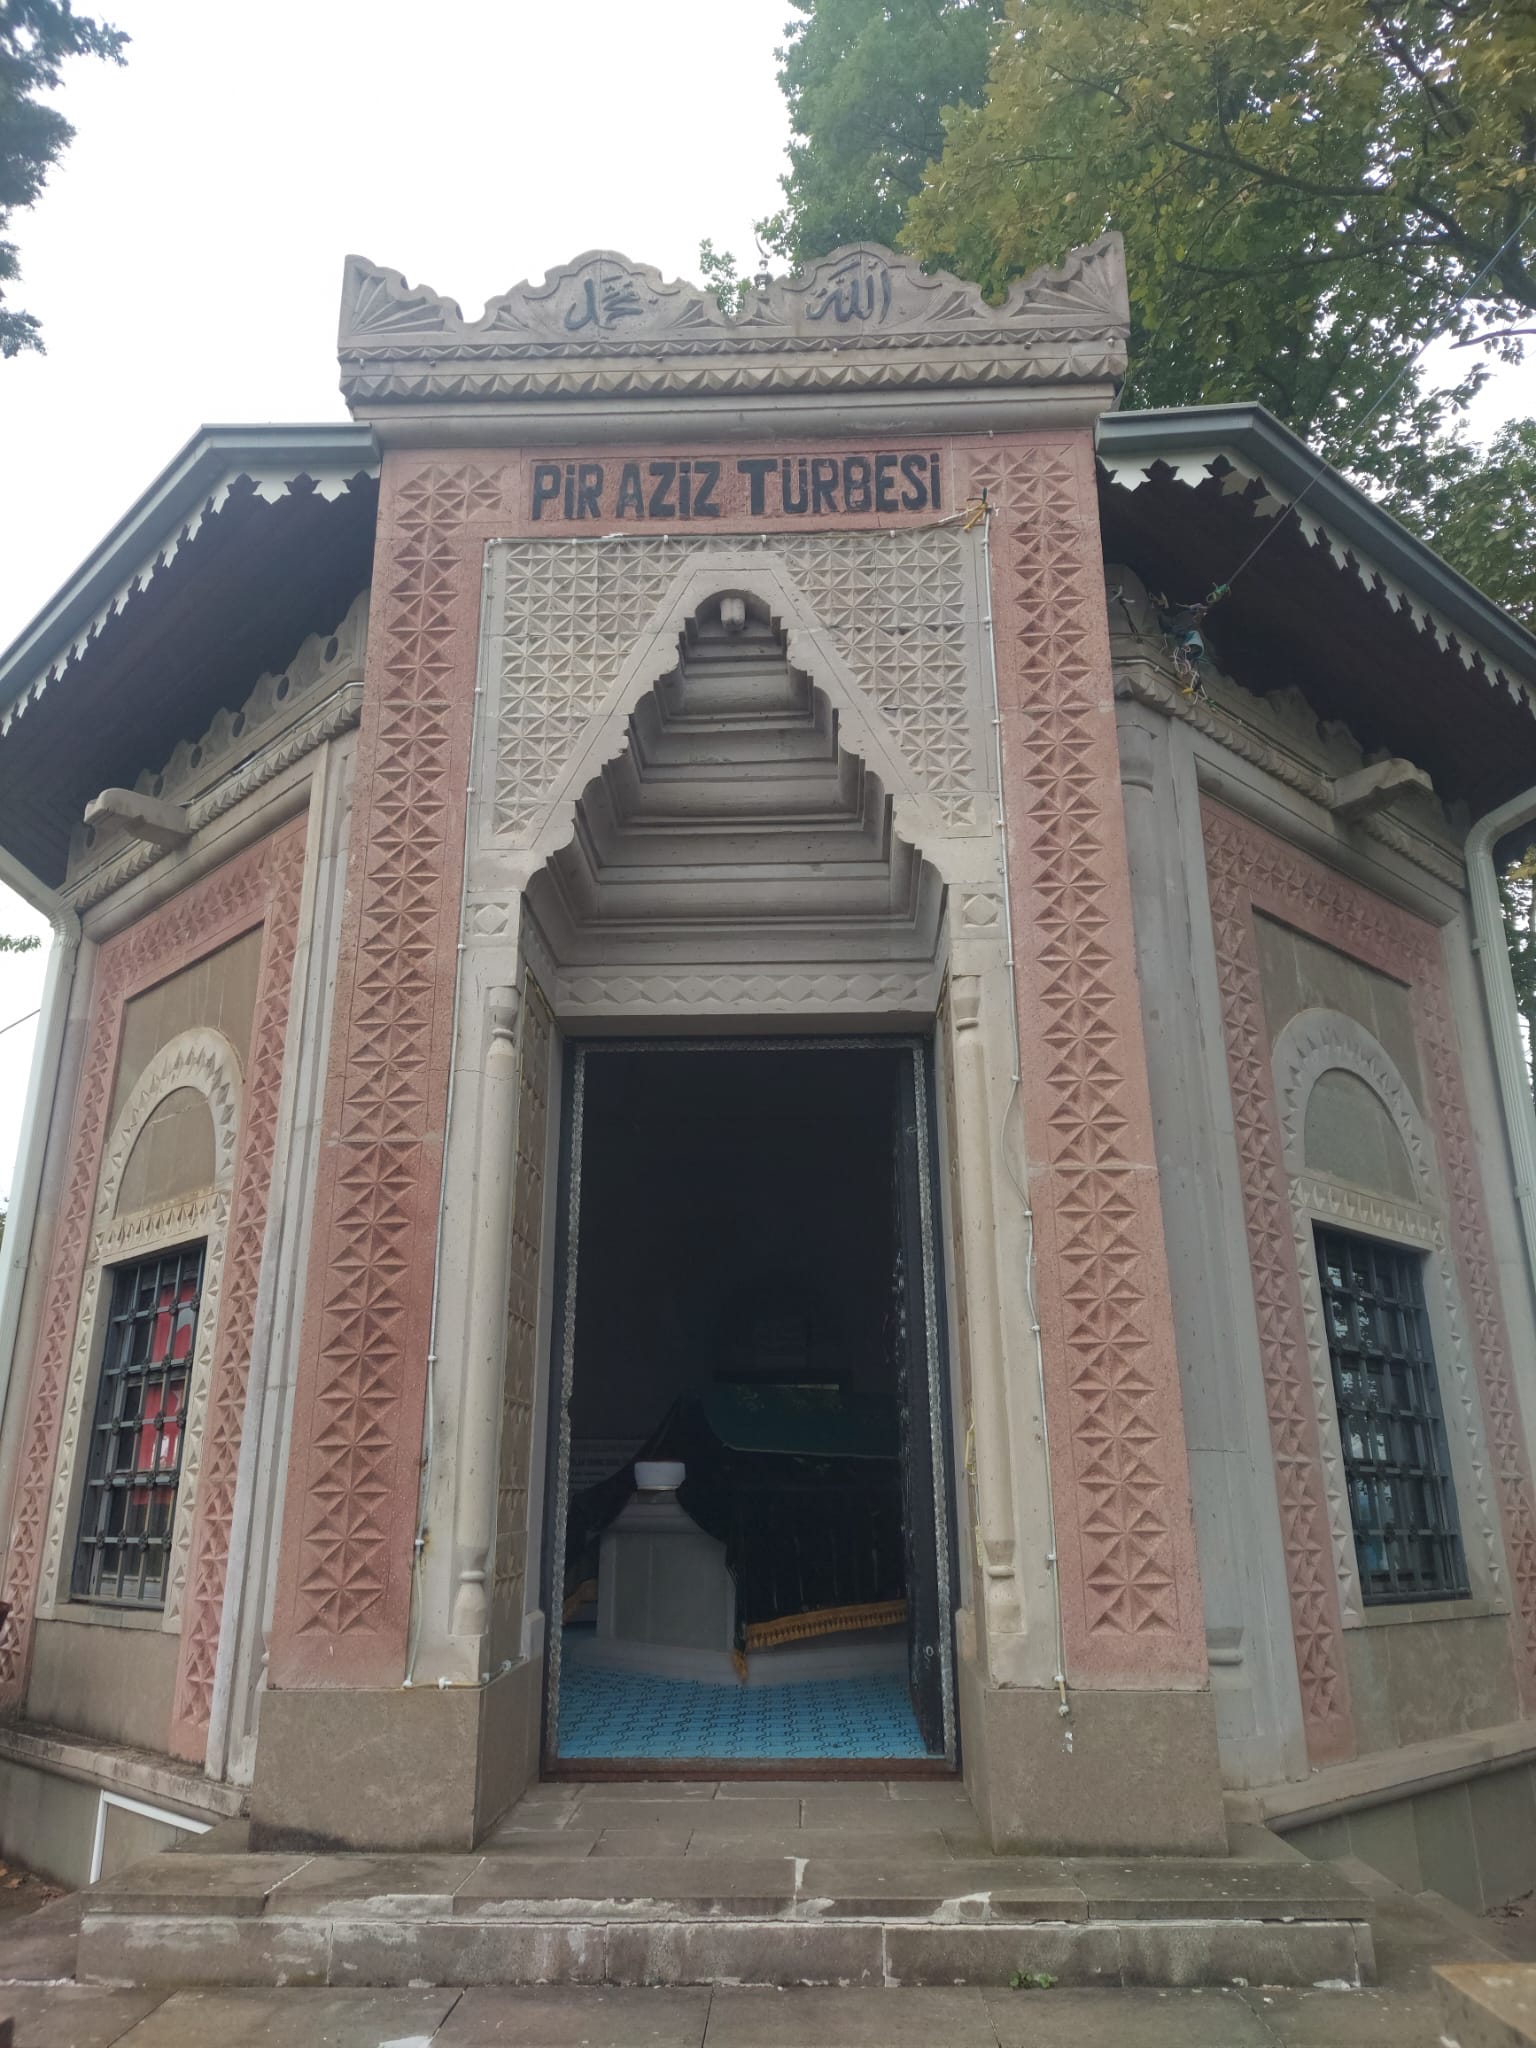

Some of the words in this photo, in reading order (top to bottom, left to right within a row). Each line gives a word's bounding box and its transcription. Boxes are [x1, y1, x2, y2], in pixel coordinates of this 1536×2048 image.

[805, 260, 892, 325] الله
[532, 463, 604, 520] PİR
[615, 461, 721, 519] AZİZ
[736, 452, 941, 515] TÜRBESİ
